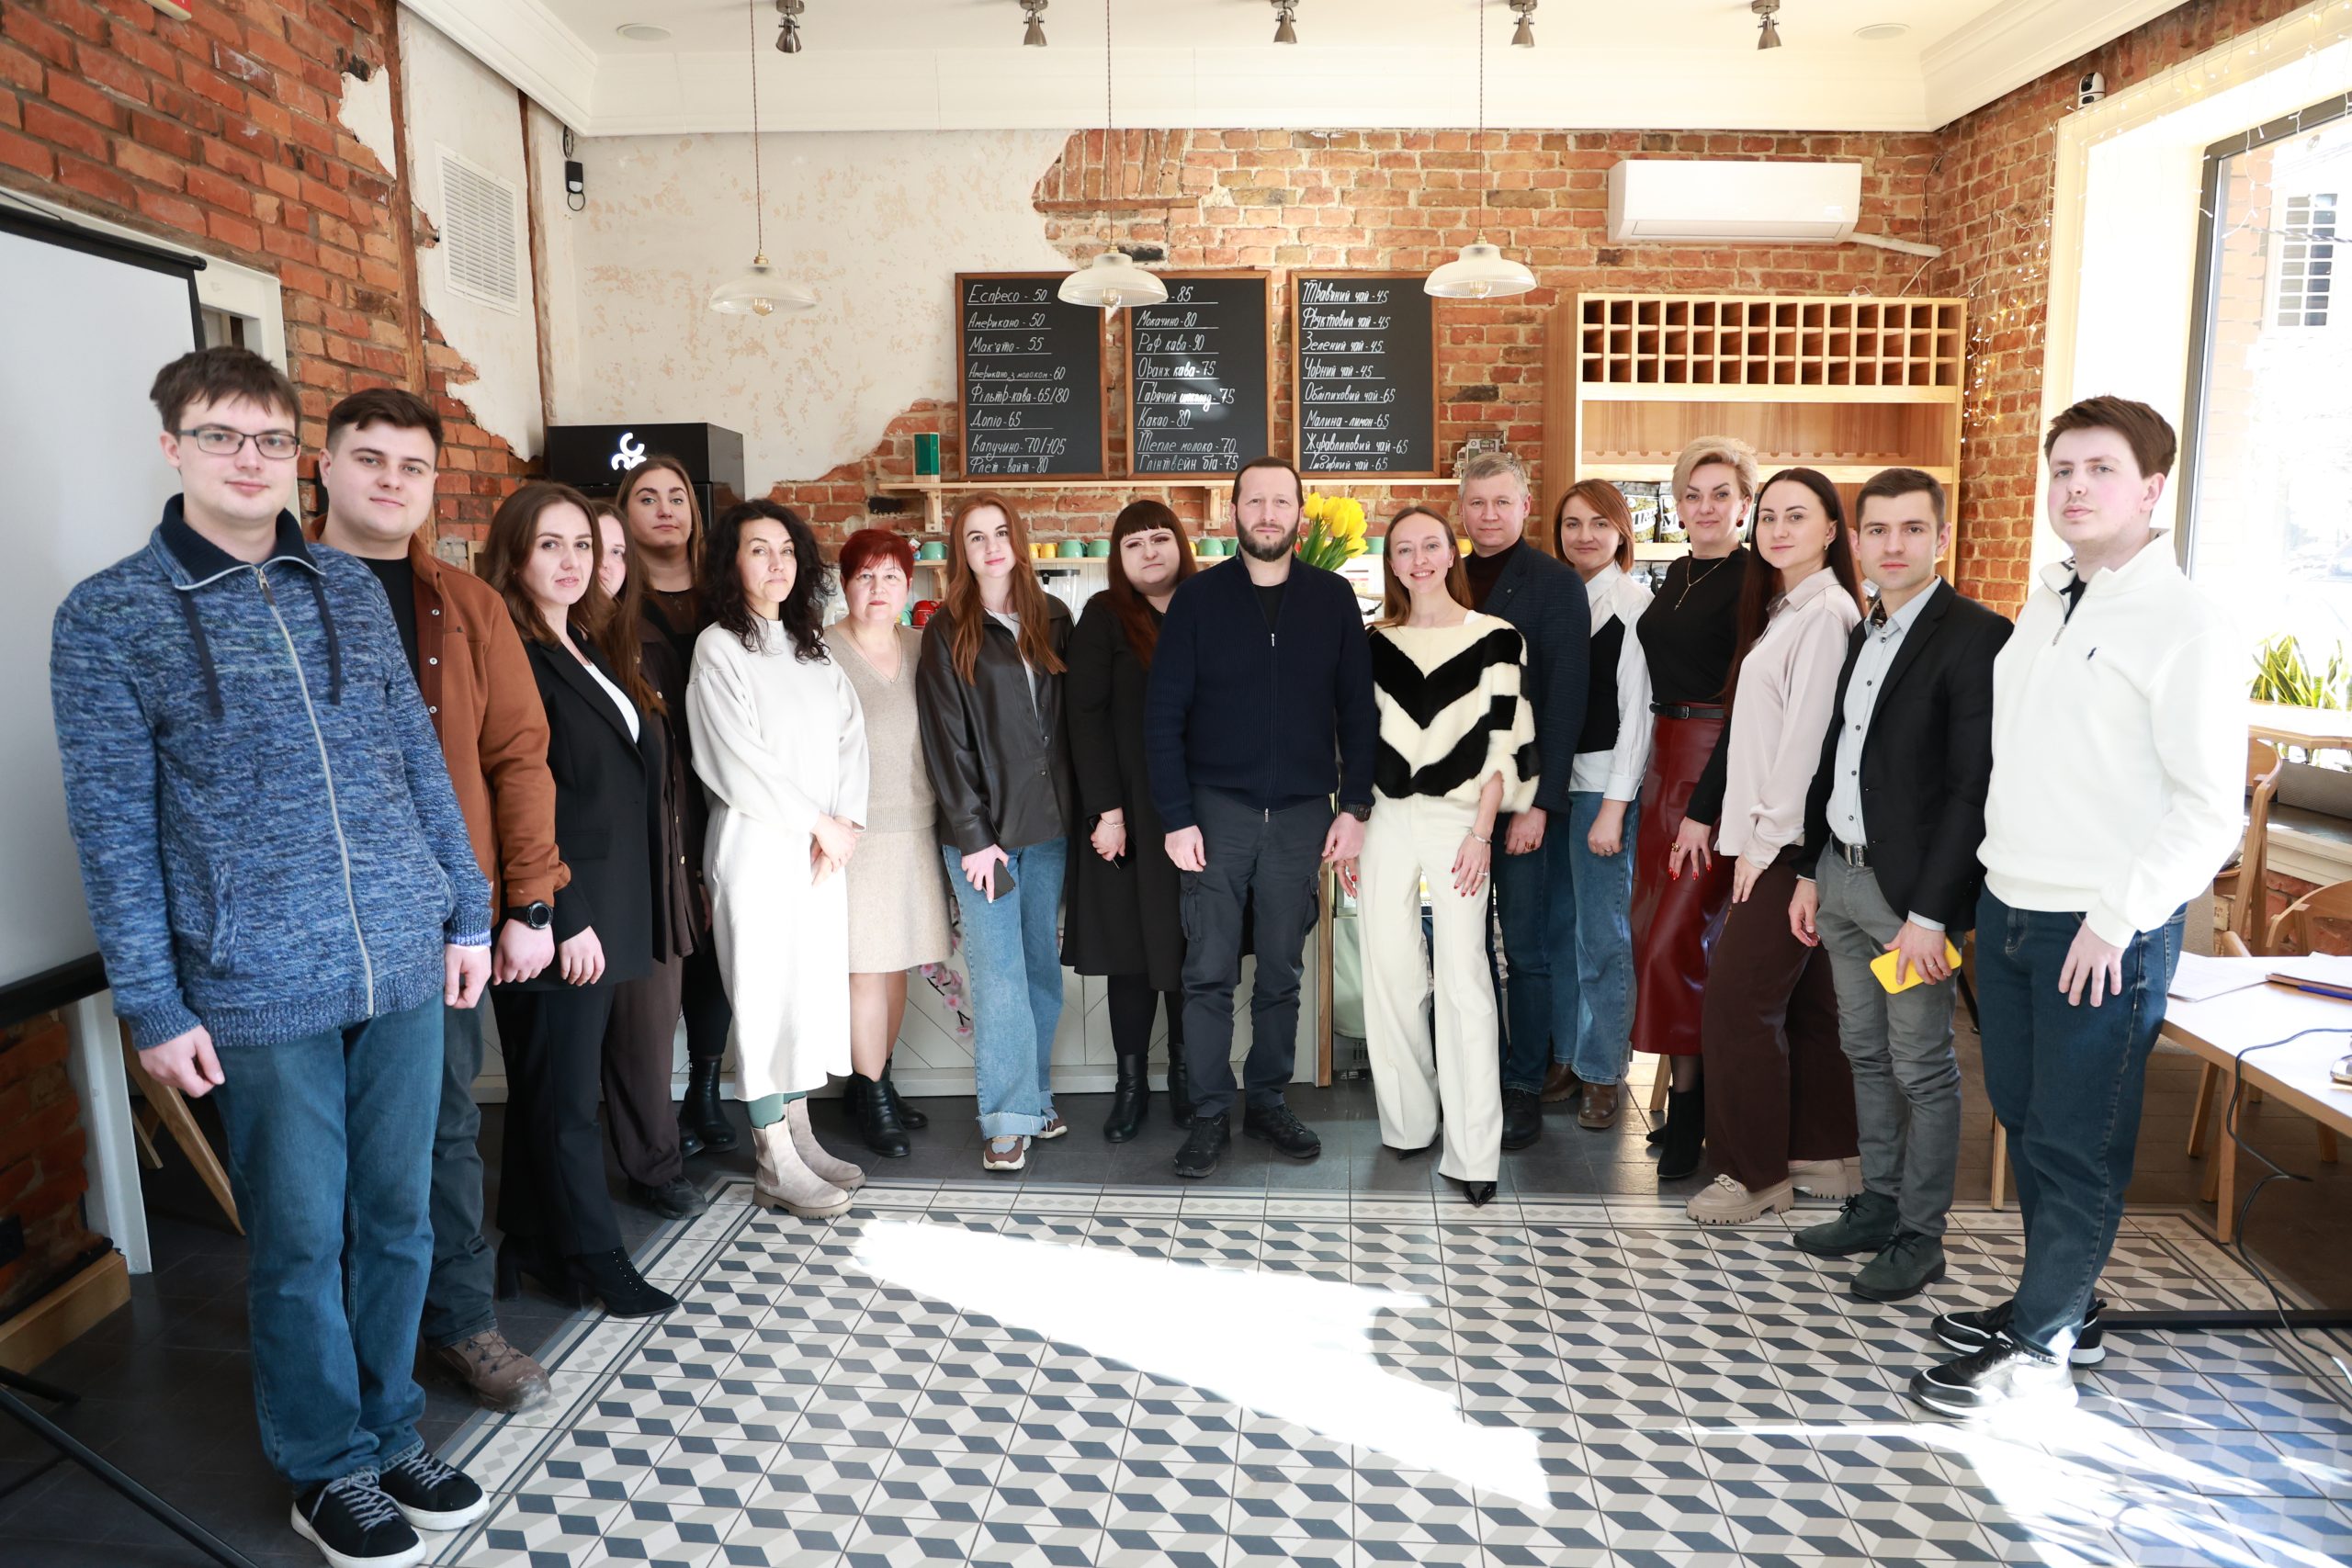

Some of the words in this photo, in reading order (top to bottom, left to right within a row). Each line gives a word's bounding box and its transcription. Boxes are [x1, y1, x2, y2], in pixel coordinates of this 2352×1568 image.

[968, 284, 1020, 304] Еспресо
[1033, 288, 1047, 301] 50
[1177, 286, 1193, 302] 85
[1355, 290, 1369, 302] чай
[1377, 290, 1389, 303] 45
[967, 311, 1020, 328] Американо
[1029, 312, 1046, 327] 50
[1136, 310, 1179, 326] Мокачино
[1184, 312, 1197, 327] 80
[1303, 307, 1354, 329] Фруктовий
[1358, 316, 1372, 328] чай
[1378, 316, 1391, 329] 45
[1028, 336, 1045, 351] 55
[1138, 333, 1161, 353] Раф
[1165, 334, 1187, 351] кава
[1302, 332, 1346, 351] Зелений
[1351, 341, 1364, 352] чай
[1371, 341, 1384, 352] 45
[968, 362, 1008, 379] Американо
[1053, 367, 1066, 380] 60
[1138, 357, 1170, 378] Оранж
[1173, 361, 1195, 378] кава
[1202, 361, 1216, 376] 75
[1305, 357, 1337, 378] Чорний
[1340, 366, 1353, 377] чай
[1361, 366, 1374, 378] 45
[1037, 387, 1070, 403] 65/80
[1137, 381, 1177, 403] Гарячий
[1219, 388, 1236, 404] 75
[1364, 390, 1378, 401] чай
[1384, 389, 1396, 402] 65
[970, 410, 1002, 427] Допіо
[1008, 412, 1022, 427] 65
[1137, 406, 1169, 427] Какао
[1177, 409, 1191, 427] 80
[1305, 410, 1342, 427] Малина
[1349, 417, 1374, 427] лимон
[1377, 413, 1390, 428] 65
[971, 434, 1020, 461] Капучино
[1137, 429, 1176, 452] Тепле
[1181, 442, 1213, 452] молоко
[1221, 437, 1237, 453] 70
[1306, 433, 1371, 453] Журавлиновий
[1376, 440, 1391, 452] чай
[1396, 439, 1408, 454] 65
[970, 457, 999, 473] Флет
[1036, 457, 1048, 473] 80
[1139, 455, 1197, 471] Глінтвейн
[1224, 455, 1239, 470] 75
[1354, 460, 1369, 470] чай
[1375, 457, 1388, 471] 65
